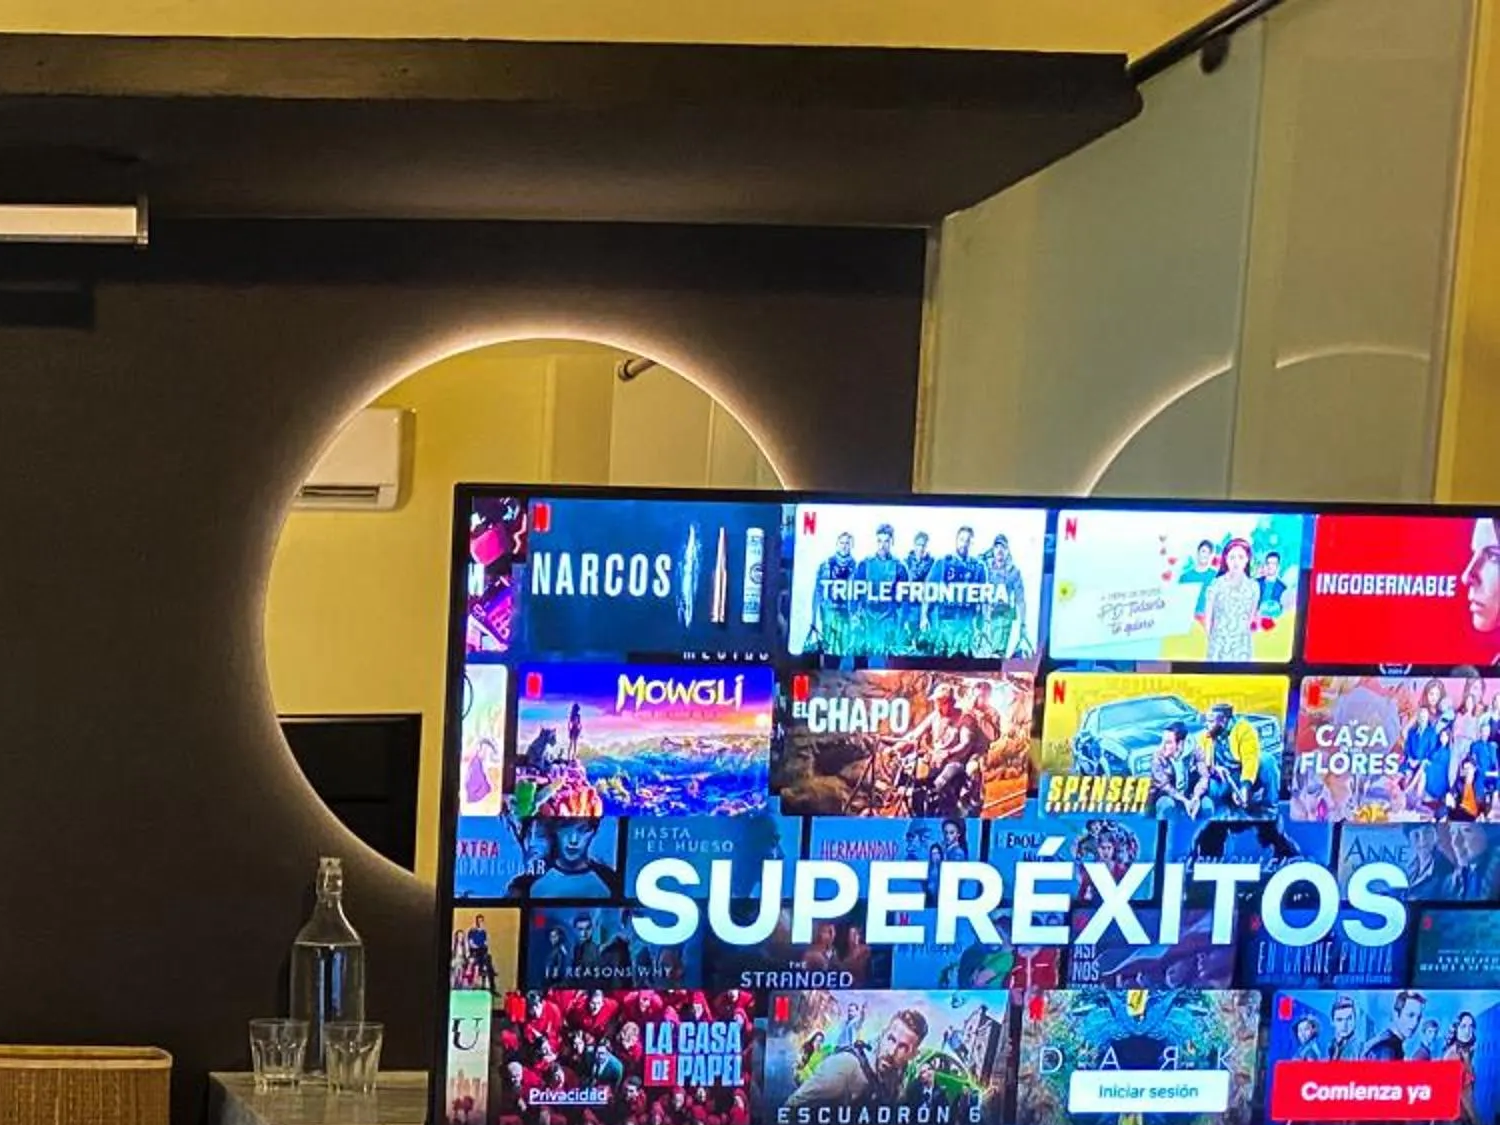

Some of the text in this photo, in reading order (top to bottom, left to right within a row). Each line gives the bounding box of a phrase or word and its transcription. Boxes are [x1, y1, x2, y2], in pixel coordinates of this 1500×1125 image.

[531, 551, 672, 599] NARCOS
[1315, 572, 1458, 598] INGOBERNABLE
[820, 578, 1009, 605] TRIPLE FRONTERA
[792, 698, 910, 734] EL CHAPO
[1315, 724, 1390, 748] CASA
[1300, 751, 1401, 776] FLORES
[1047, 775, 1153, 803] SPENSER
[634, 826, 692, 840] HASTA
[631, 836, 1410, 947] SUPERÉXITOS
[740, 970, 854, 989] STRANDED
[645, 1021, 741, 1055] LA CASA
[651, 1055, 745, 1087] DE PAPEL
[529, 1087, 608, 1105] Privacidad
[1099, 1083, 1198, 1100] Iniciar sesión
[1301, 1081, 1432, 1105] Comienza ya
[776, 1101, 982, 1125] ESCUADRÓN 6
